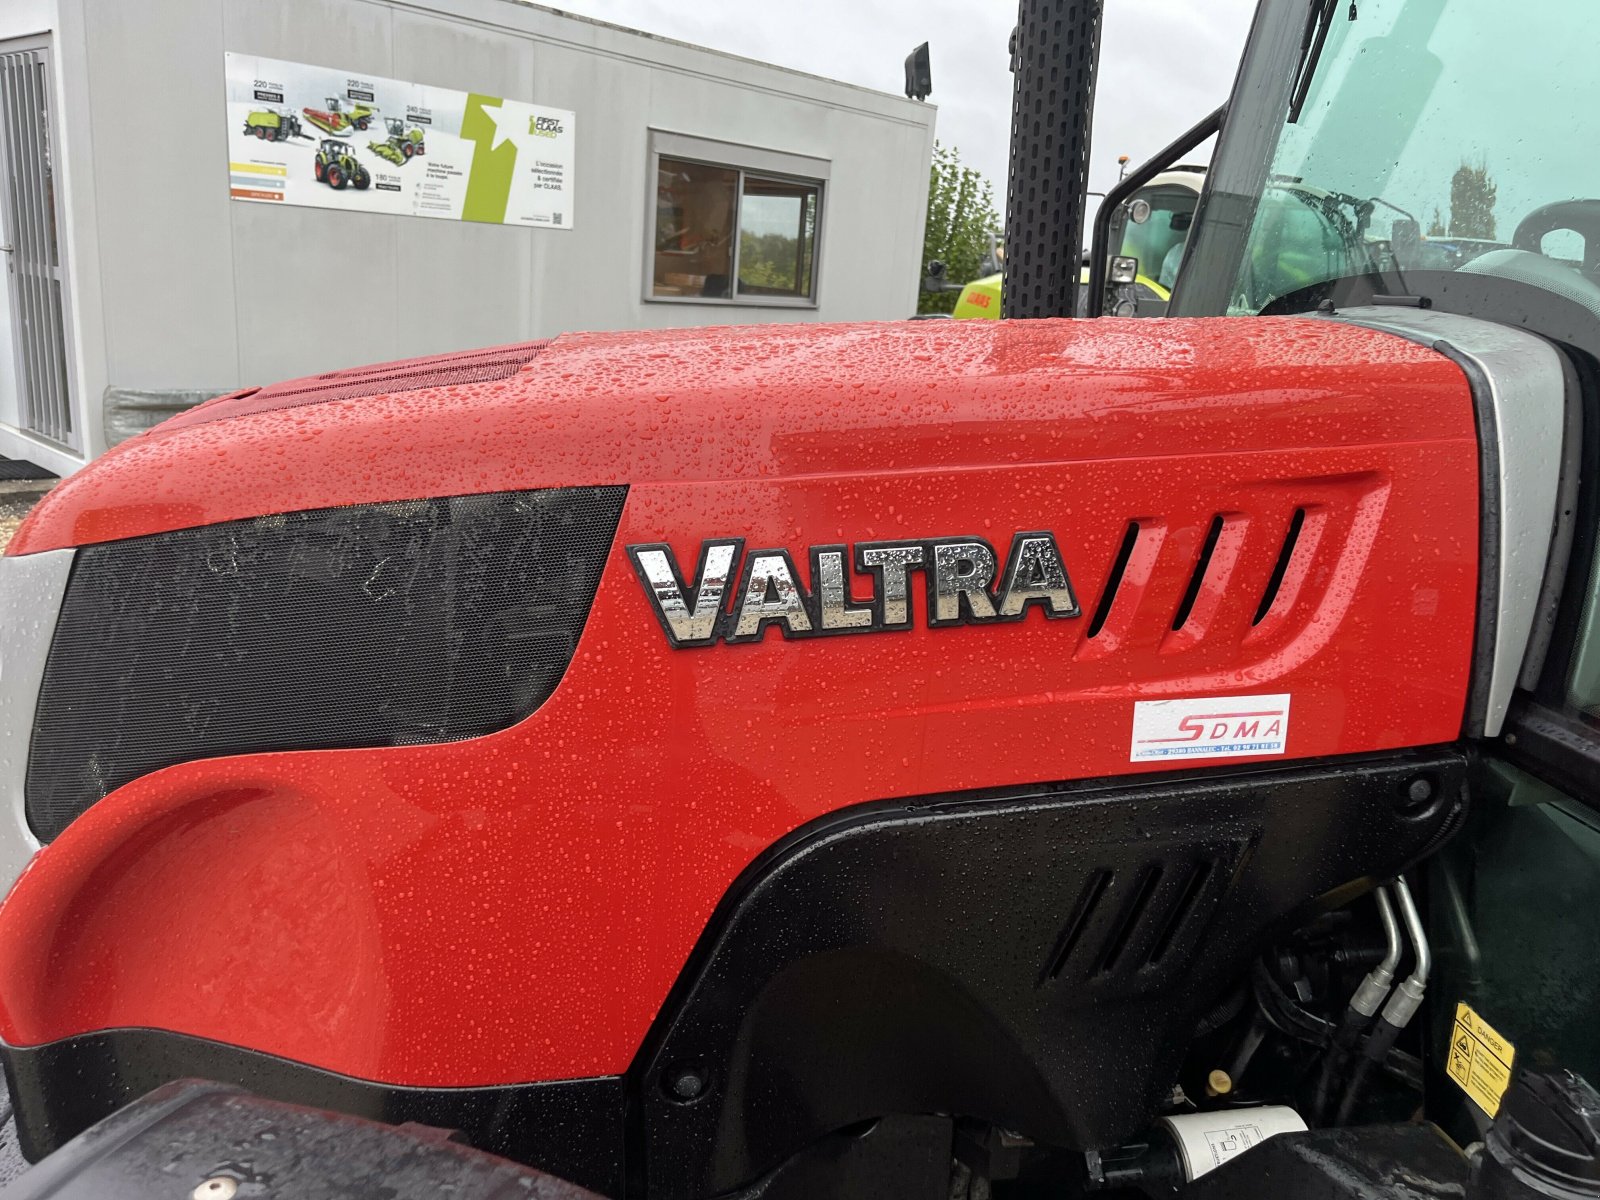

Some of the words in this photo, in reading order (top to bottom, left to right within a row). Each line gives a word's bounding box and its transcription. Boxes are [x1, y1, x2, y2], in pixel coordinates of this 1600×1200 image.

[253, 80, 268, 89] 220
[347, 80, 360, 88] 220
[406, 105, 418, 113] 240
[537, 116, 560, 127] FIRST
[536, 123, 564, 134] CLAAS
[376, 174, 388, 182] 180
[628, 533, 1079, 646] VALTRA
[1176, 711, 1284, 742] SDMA
[1477, 1027, 1503, 1052] DANGER
